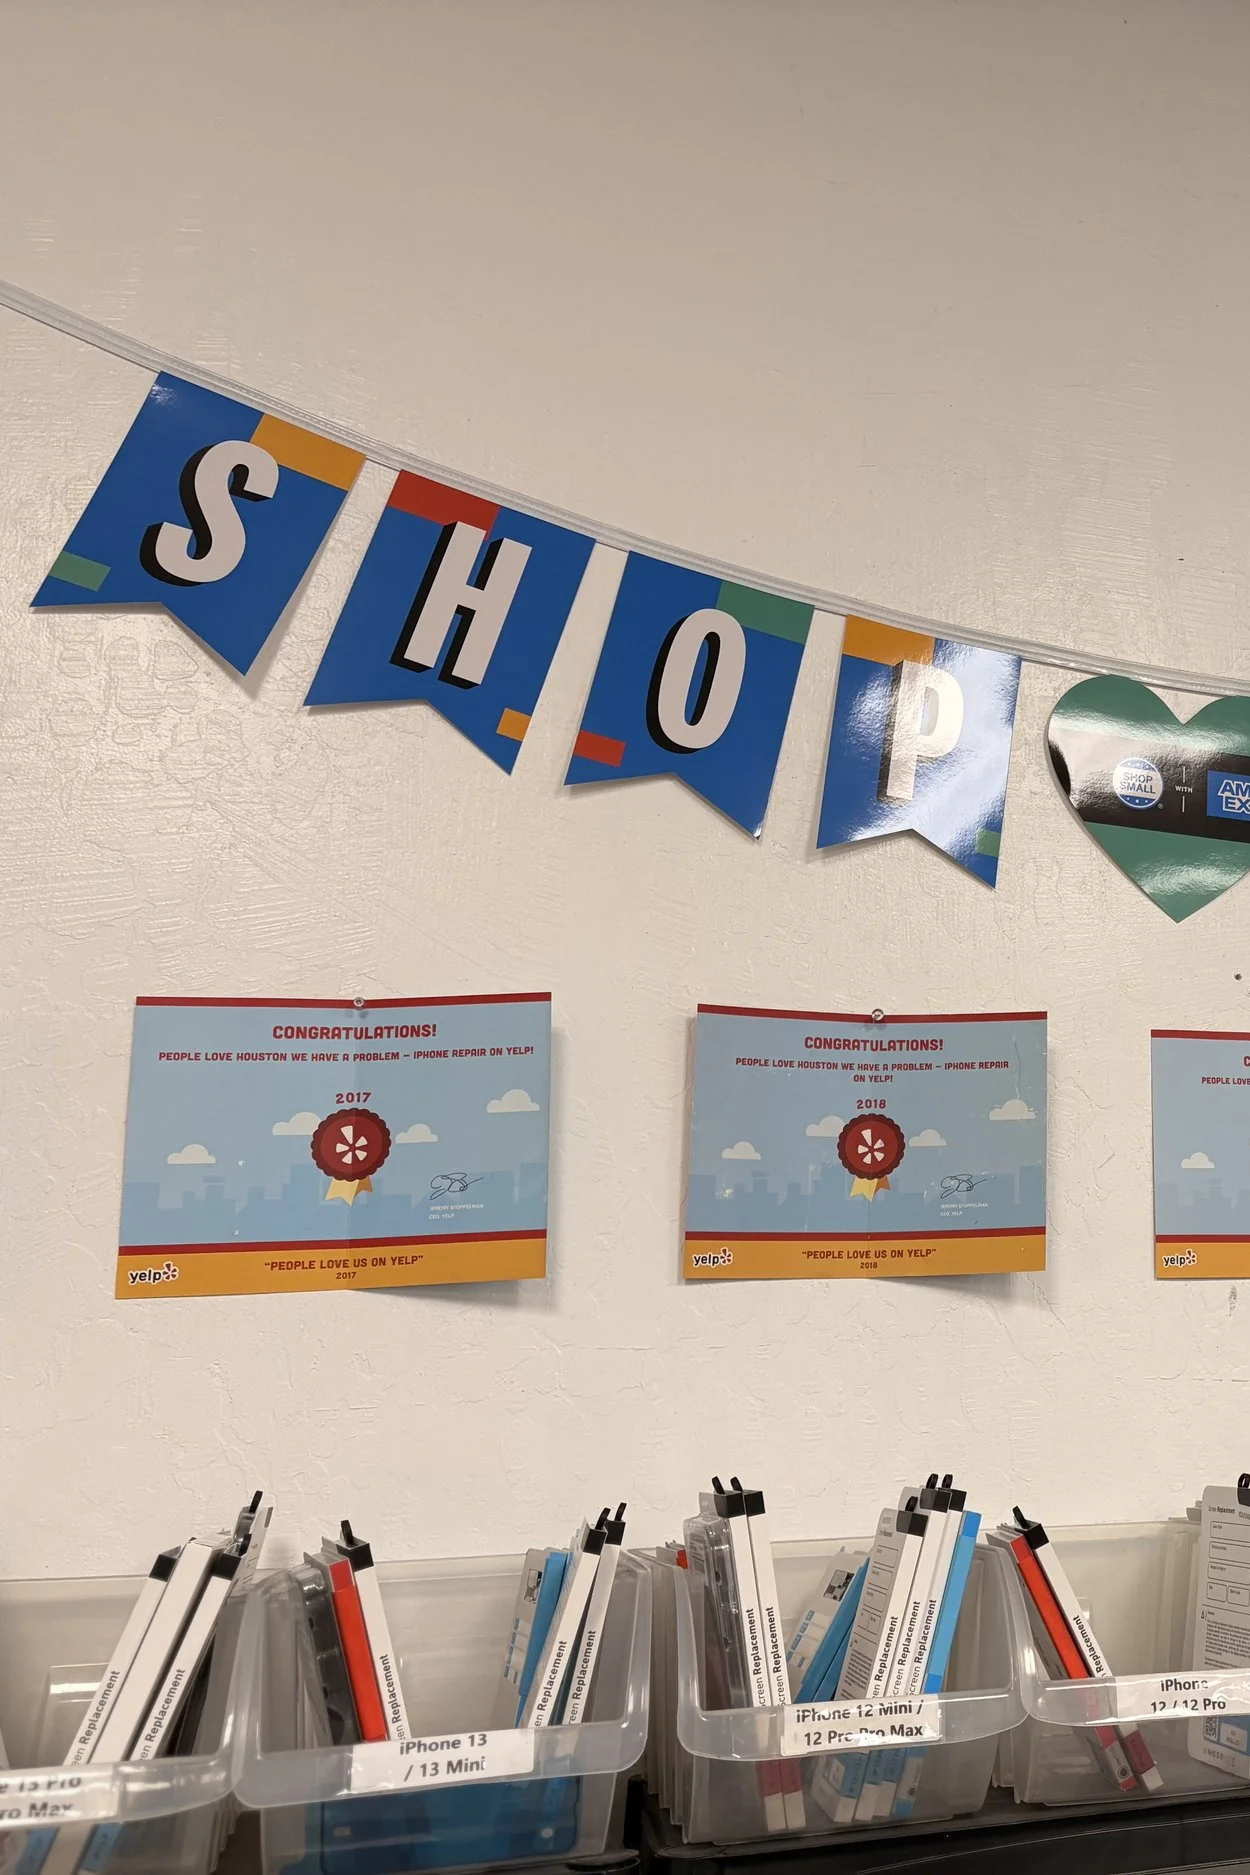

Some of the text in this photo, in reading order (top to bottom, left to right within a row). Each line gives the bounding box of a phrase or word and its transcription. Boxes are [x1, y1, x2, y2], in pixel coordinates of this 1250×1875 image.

[1124, 772, 1153, 783] SHOP
[1120, 781, 1156, 794] SMALL
[1175, 785, 1192, 793] WITH
[272, 1024, 437, 1040] CONGRATULATIONS!
[804, 1036, 944, 1052] CONGRATULATIONS!
[159, 1052, 201, 1061] PEOPLE
[205, 1052, 232, 1061] LOVE
[237, 1053, 287, 1061] HOUSTON
[291, 1053, 307, 1061] WE
[311, 1053, 339, 1061] HAVE
[342, 1053, 349, 1061] A
[353, 1052, 399, 1061] PROBLEM
[414, 1050, 448, 1059] IPHONE
[452, 1048, 486, 1058] REPAIR
[490, 1048, 502, 1056] ON
[506, 1046, 533, 1055] YELP!
[1201, 1077, 1230, 1085] PEOPLE
[1232, 1077, 1250, 1085] LOVE
[335, 1092, 372, 1104] 2017
[857, 1099, 886, 1109] 2018
[320, 1259, 349, 1269] LOVE
[353, 1258, 367, 1268] US
[371, 1257, 386, 1267] ON
[693, 1253, 720, 1267] yelp
[1163, 1255, 1185, 1267] yelp
[129, 1268, 162, 1284] yelp
[336, 1271, 356, 1280] 2017
[766, 1606, 782, 1673] Replacement
[898, 1601, 921, 1666] Replacement
[915, 1599, 937, 1664] Replacement
[747, 1608, 763, 1675] Replacement
[876, 1616, 898, 1682] Replacement
[1072, 1615, 1102, 1673] Replacement
[572, 1630, 596, 1700] Replacement
[537, 1640, 568, 1712] Replacement
[380, 1654, 400, 1724] Replacement
[79, 1670, 120, 1745] Replacement
[145, 1668, 185, 1742] Replacement
[400, 1734, 487, 1755] iPhone 13
[404, 1757, 485, 1782] / 13 Mini
